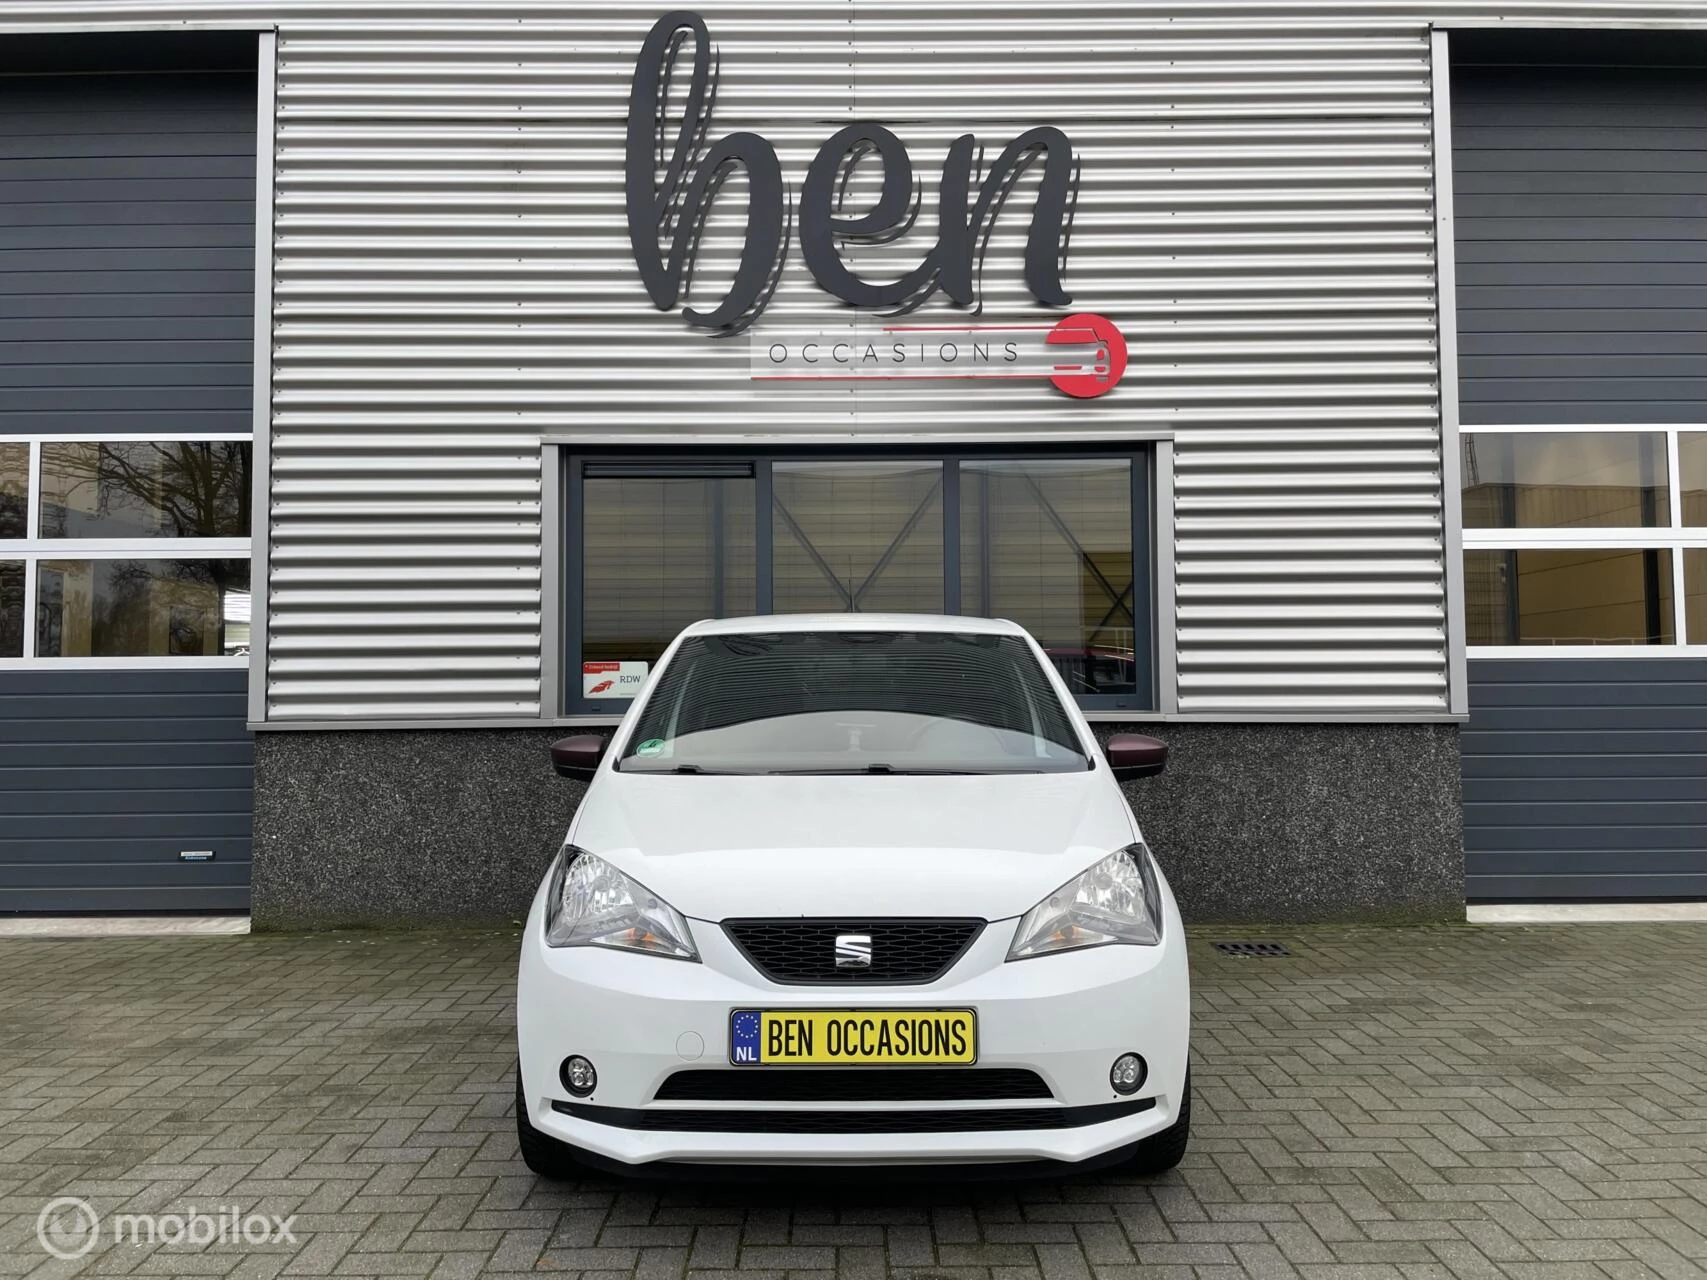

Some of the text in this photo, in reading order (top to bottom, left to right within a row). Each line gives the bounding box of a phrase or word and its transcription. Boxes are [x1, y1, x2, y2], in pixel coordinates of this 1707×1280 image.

[625, 10, 1077, 330] ben
[768, 342, 1019, 364] OCCASIONS
[619, 675, 641, 684] RDW
[768, 1019, 967, 1056] BEN OCCASIONS
[735, 1046, 758, 1061] NL
